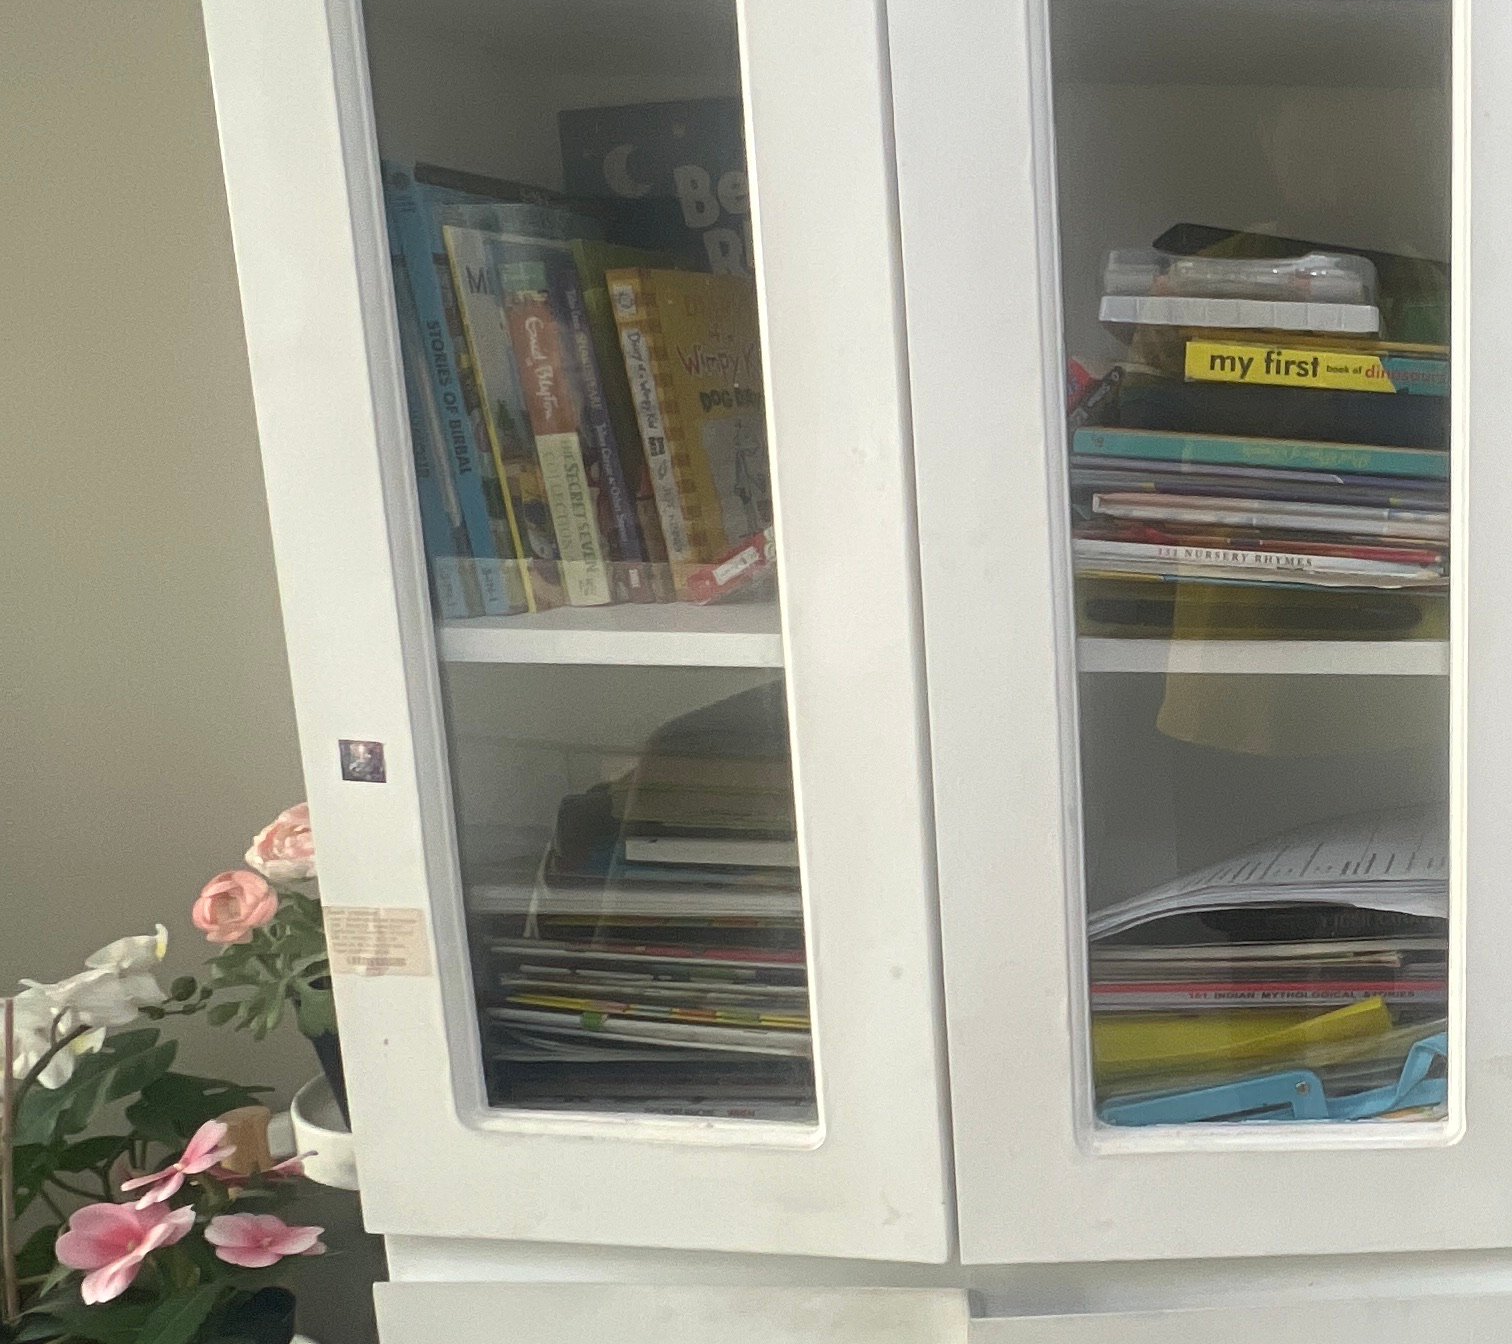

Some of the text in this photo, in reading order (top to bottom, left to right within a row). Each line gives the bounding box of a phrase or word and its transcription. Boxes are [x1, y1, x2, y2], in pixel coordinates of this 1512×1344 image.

[426, 320, 473, 475] STORIES OF BIRBAL
[523, 315, 556, 420] Enid Blyton
[1210, 353, 1254, 380] my
[1264, 350, 1320, 378] first
[1326, 364, 1350, 376] book
[1352, 365, 1363, 376] of
[565, 462, 586, 518] SECRET
[577, 521, 600, 574] SEVEN
[1184, 548, 1250, 564] NURSERY
[1254, 552, 1314, 568] RHYMES
